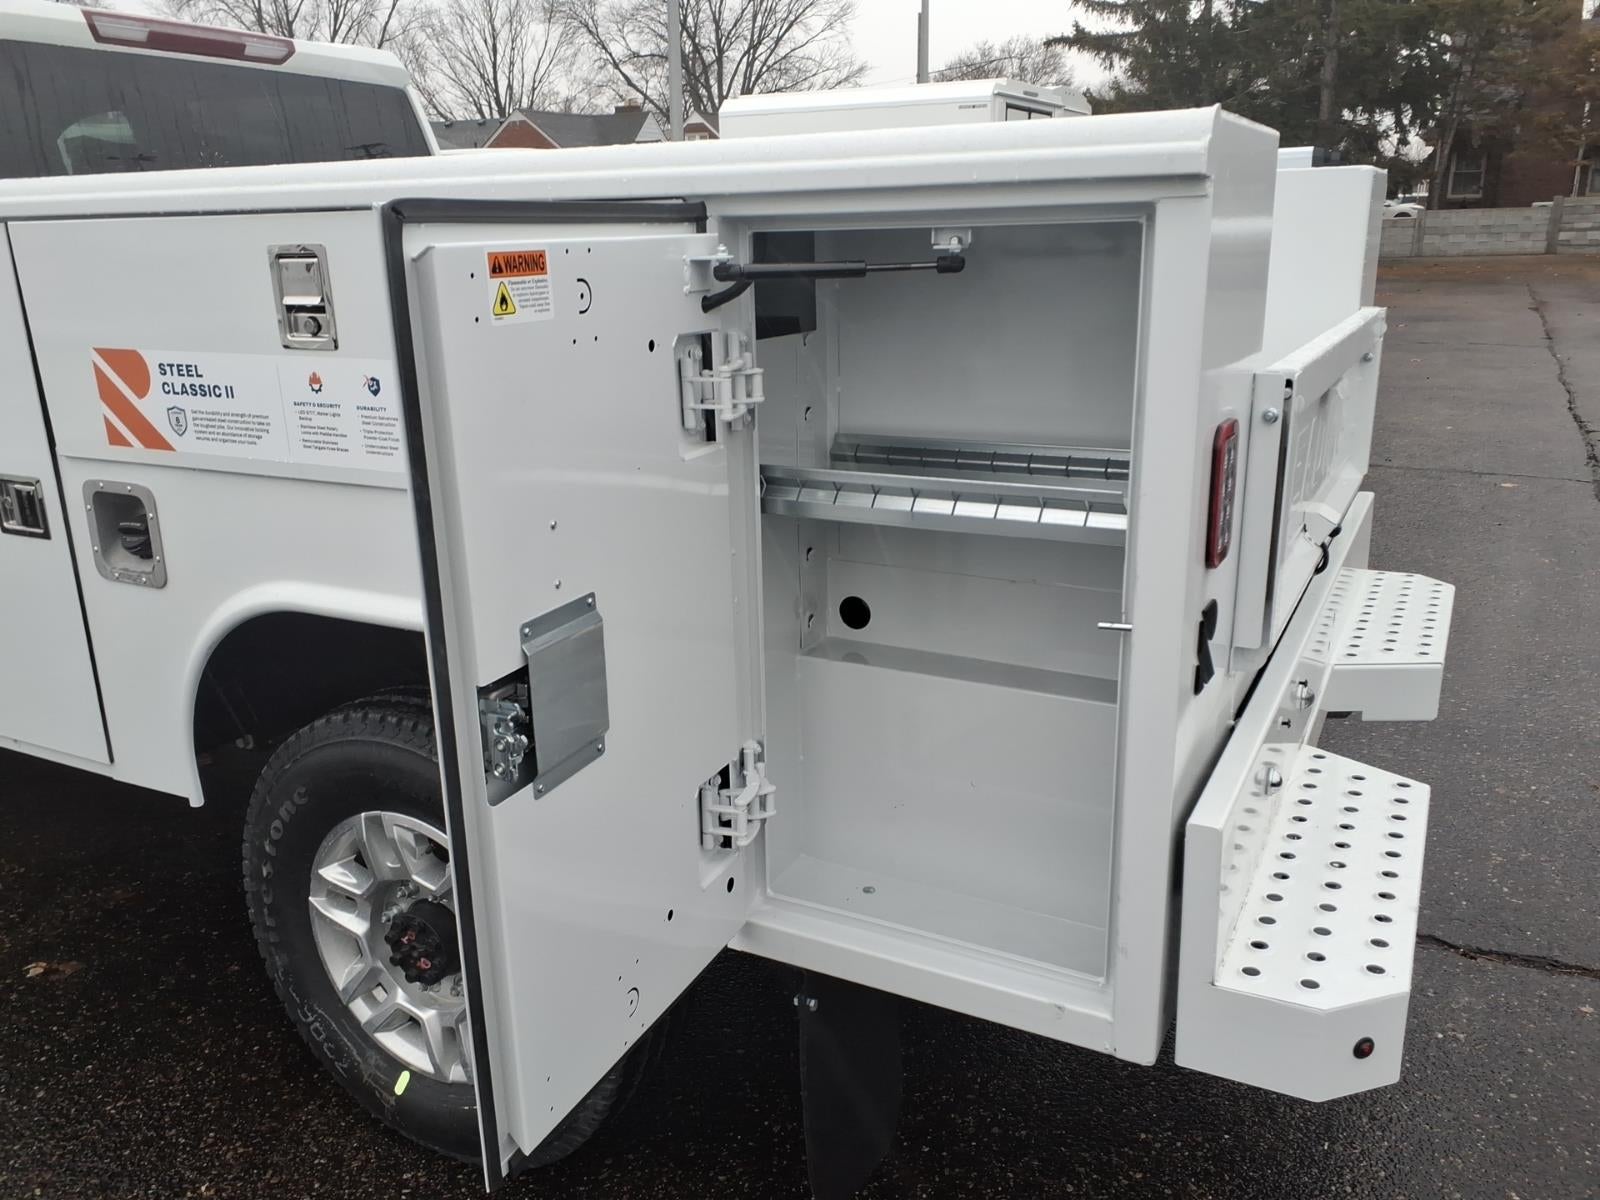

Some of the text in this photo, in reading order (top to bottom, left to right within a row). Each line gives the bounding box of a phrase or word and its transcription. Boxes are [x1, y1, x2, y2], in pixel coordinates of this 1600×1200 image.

[503, 253, 545, 273] WARNING
[158, 362, 203, 378] STEEL
[161, 381, 235, 399] CLASSIC II
